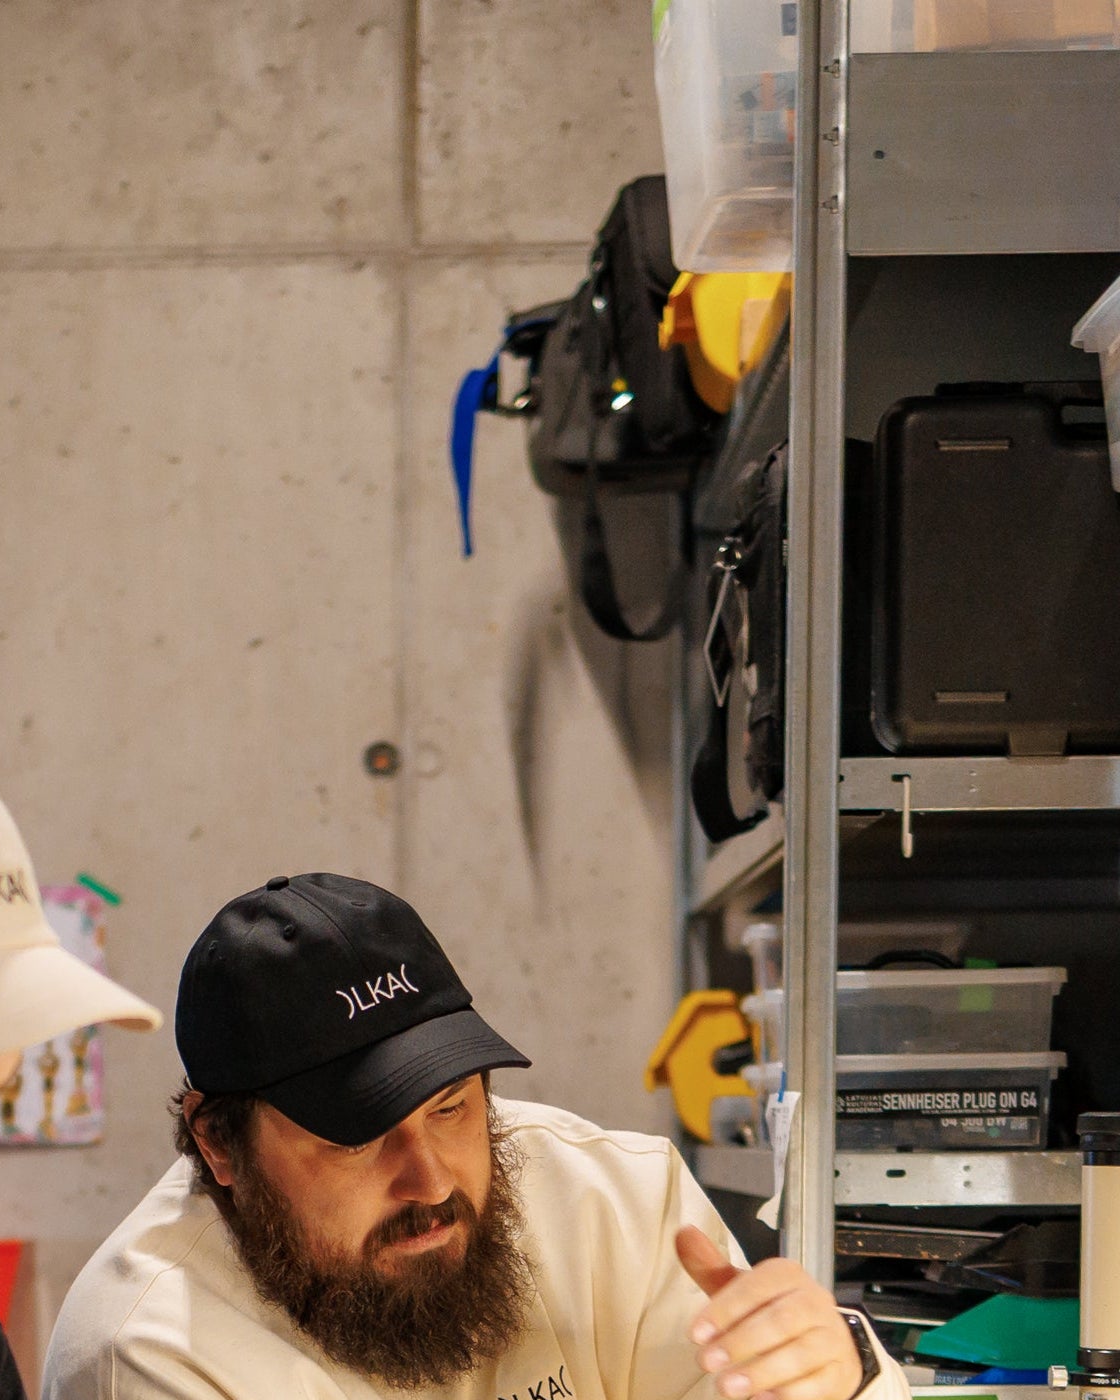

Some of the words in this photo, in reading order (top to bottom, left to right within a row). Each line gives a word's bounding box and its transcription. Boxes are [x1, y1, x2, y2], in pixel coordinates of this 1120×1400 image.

[882, 1093, 960, 1110] SENNHEISER
[962, 1092, 997, 1110] PLUG
[999, 1092, 1017, 1109] ON
[1020, 1091, 1038, 1108] G4
